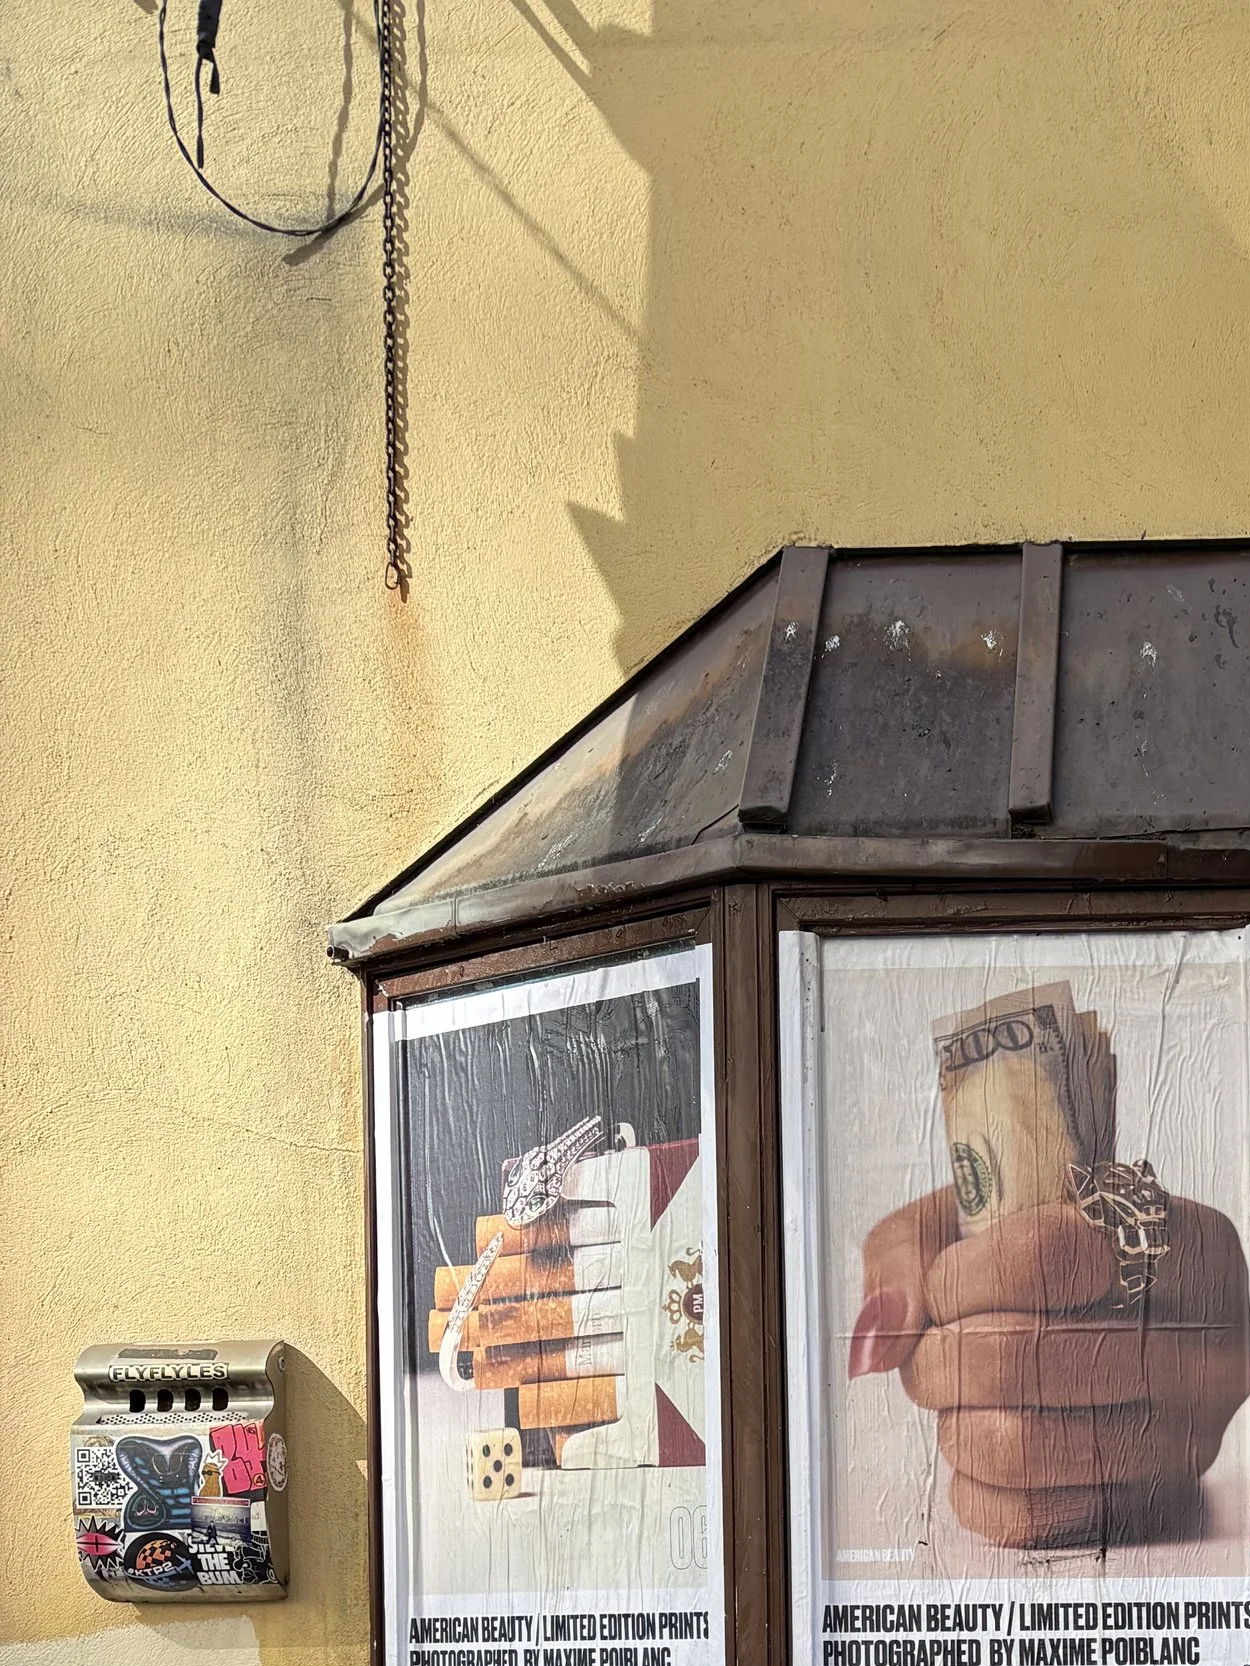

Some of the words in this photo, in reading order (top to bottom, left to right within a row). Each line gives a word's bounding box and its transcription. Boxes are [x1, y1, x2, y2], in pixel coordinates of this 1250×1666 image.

[943, 1020, 1034, 1071] 100
[693, 1294, 703, 1313] PM
[197, 1553, 230, 1571] THE
[837, 1548, 881, 1562] AMERICAN
[197, 1571, 241, 1585] BUM
[410, 1617, 478, 1644] AMERICAN
[482, 1615, 533, 1642] BEAUTY
[536, 1612, 540, 1646] /
[543, 1613, 597, 1642] LIMITED
[600, 1612, 655, 1640] EDITION
[822, 1604, 922, 1633] AMERICAN
[927, 1603, 1004, 1632] BEAUTY
[1007, 1601, 1015, 1636] /
[1019, 1602, 1098, 1632] LIMITED
[1102, 1601, 1180, 1631] EDITION
[990, 1638, 1016, 1666] BY
[1019, 1638, 1098, 1666] MAXIME
[1102, 1636, 1200, 1666] POIBLANC
